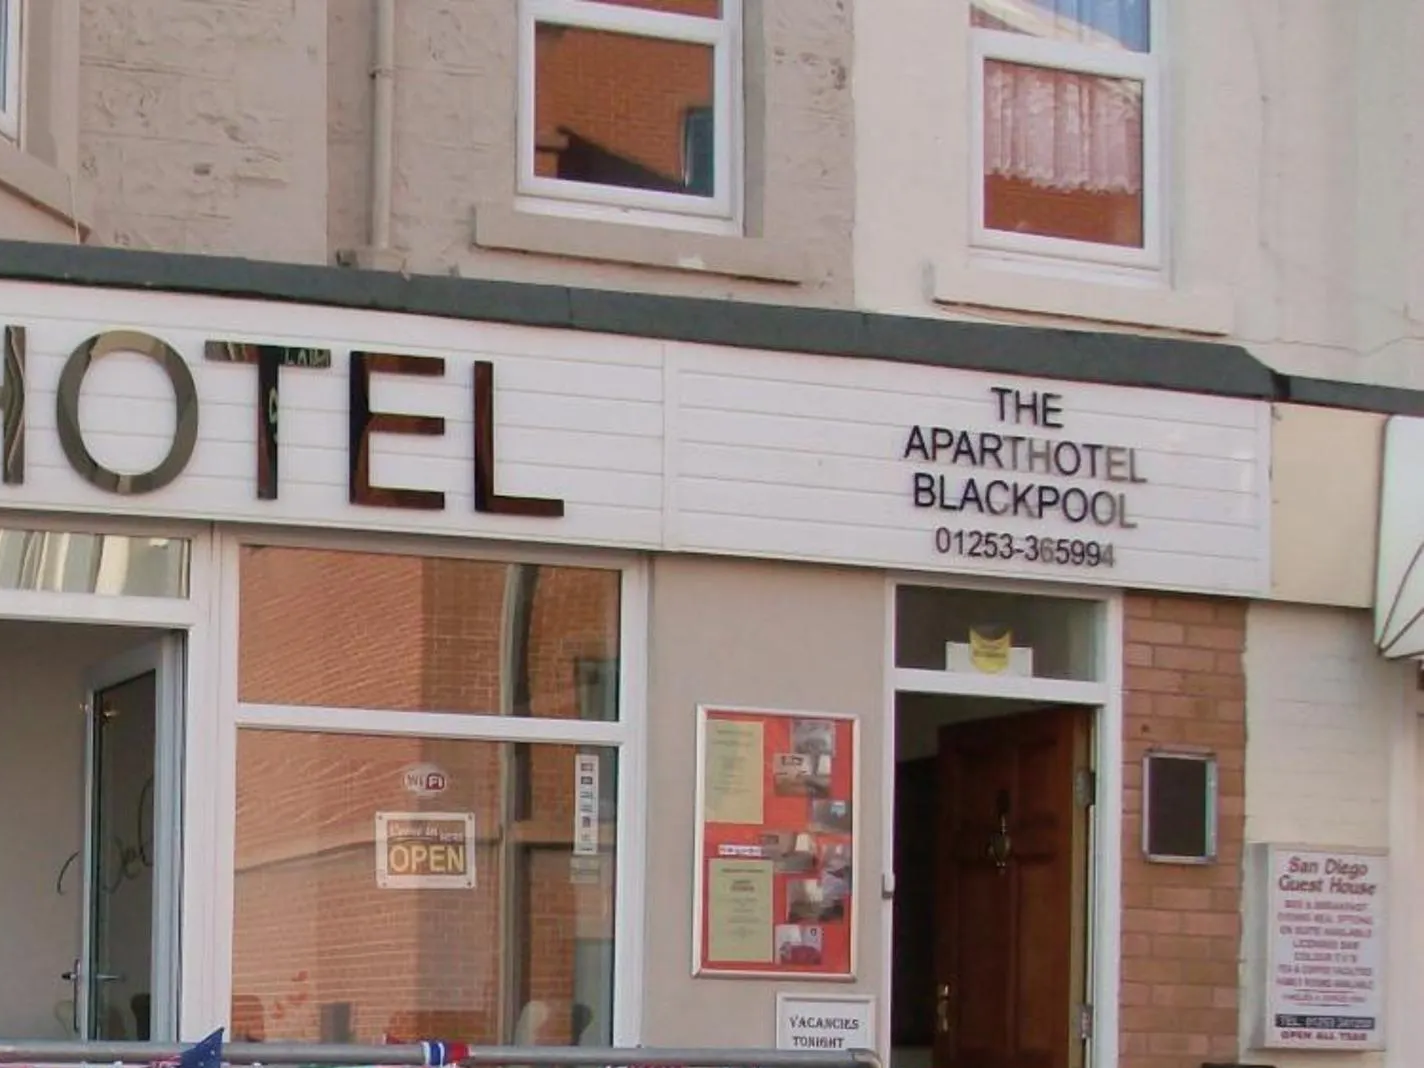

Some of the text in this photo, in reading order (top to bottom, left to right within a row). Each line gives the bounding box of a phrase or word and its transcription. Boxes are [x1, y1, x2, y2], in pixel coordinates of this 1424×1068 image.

[991, 386, 1064, 429] THE
[904, 425, 1147, 483] APARTHOTEL
[913, 472, 1137, 529] BLACKPOOL
[935, 527, 1115, 568] 01253-365994
[389, 843, 465, 874] OPEN
[1288, 855, 1368, 880] San Diego
[1279, 873, 1376, 896] Guest House
[789, 1014, 860, 1030] VACANCIES
[793, 1036, 845, 1048] TONIGHT
